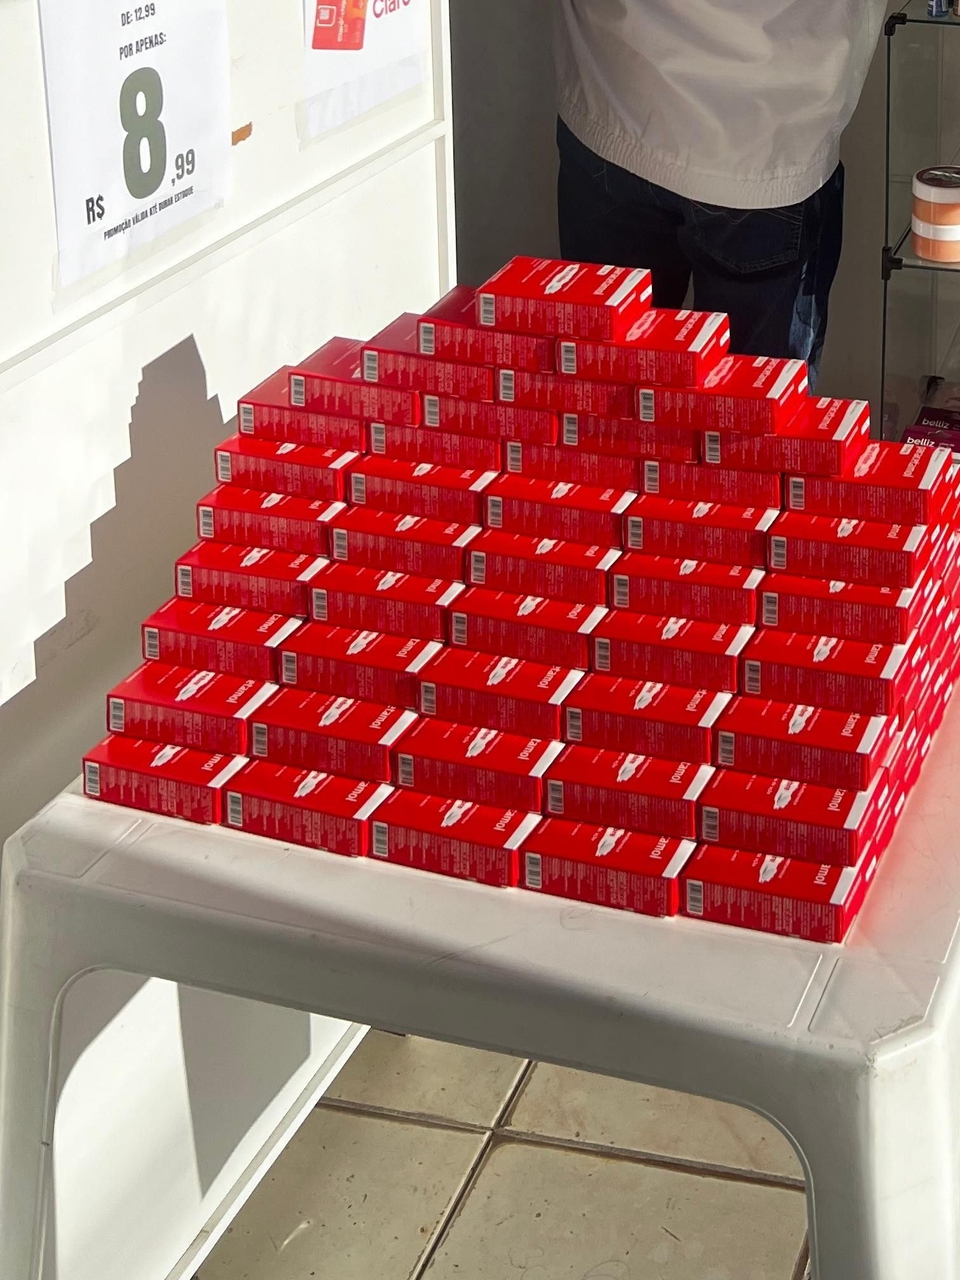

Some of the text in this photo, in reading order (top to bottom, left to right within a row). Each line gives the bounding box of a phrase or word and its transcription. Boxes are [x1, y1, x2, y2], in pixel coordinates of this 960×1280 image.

[121, 2, 156, 27] DE: 12,99
[119, 31, 167, 61] POR APENAS:
[119, 66, 196, 200] 8 ,99
[85, 194, 105, 225] R$
[103, 218, 131, 241] PROMOÇÃO
[174, 186, 194, 204] ESTOQUE
[921, 417, 950, 429] belliz
[906, 436, 935, 447] belliz
